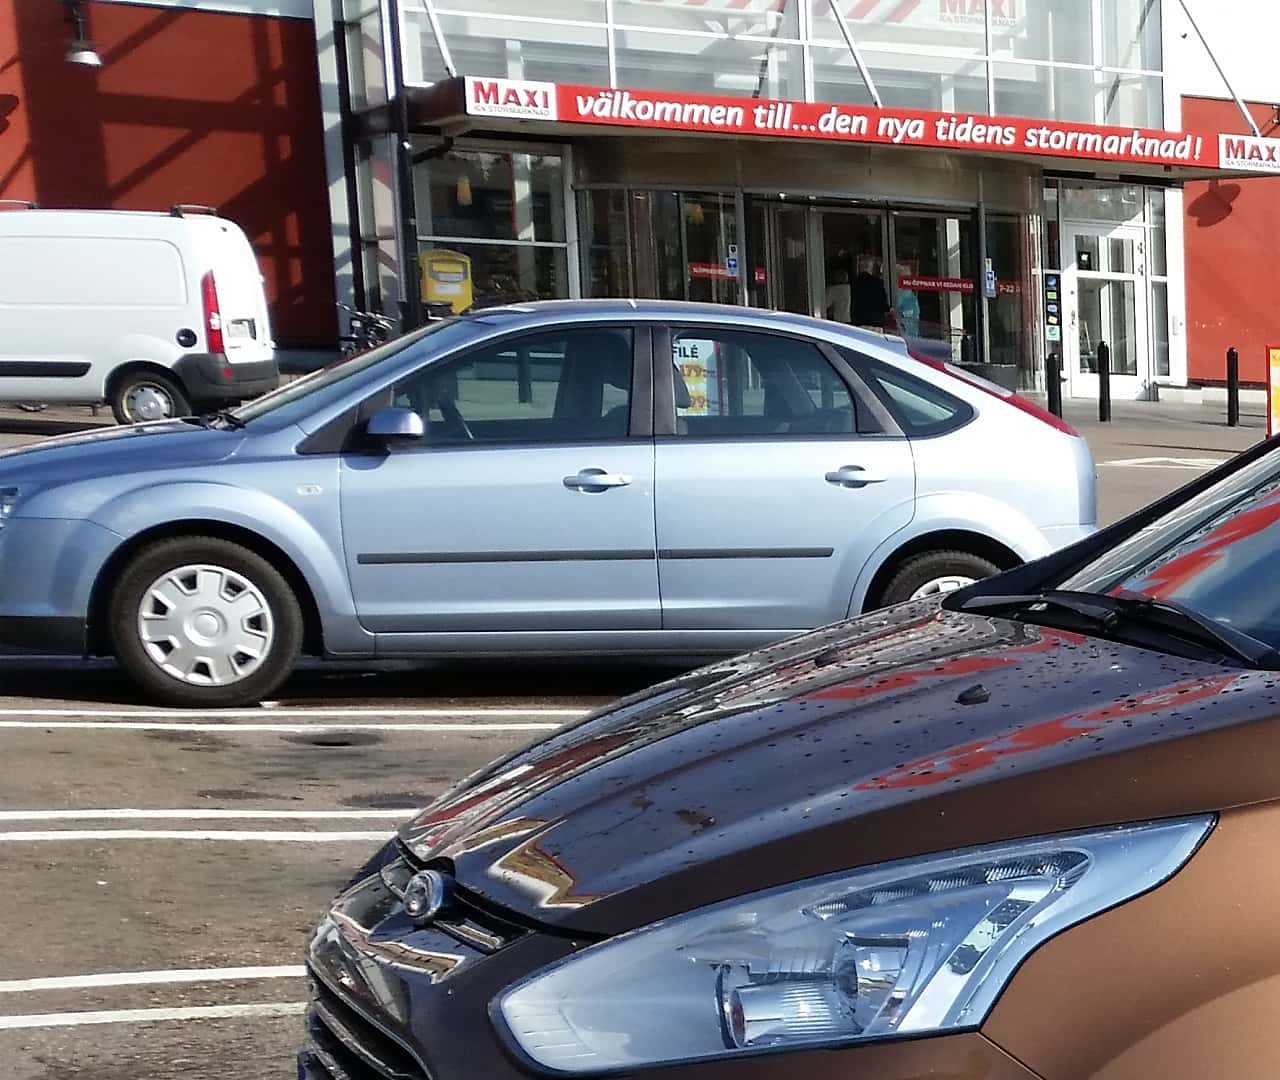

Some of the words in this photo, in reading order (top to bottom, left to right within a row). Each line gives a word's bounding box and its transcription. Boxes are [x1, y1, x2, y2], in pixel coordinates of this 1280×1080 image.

[473, 81, 549, 108] MAXI
[576, 91, 744, 127] välkommen
[877, 116, 925, 143] nya
[935, 117, 1015, 146] tidens
[1024, 126, 1202, 160] stormarknad!
